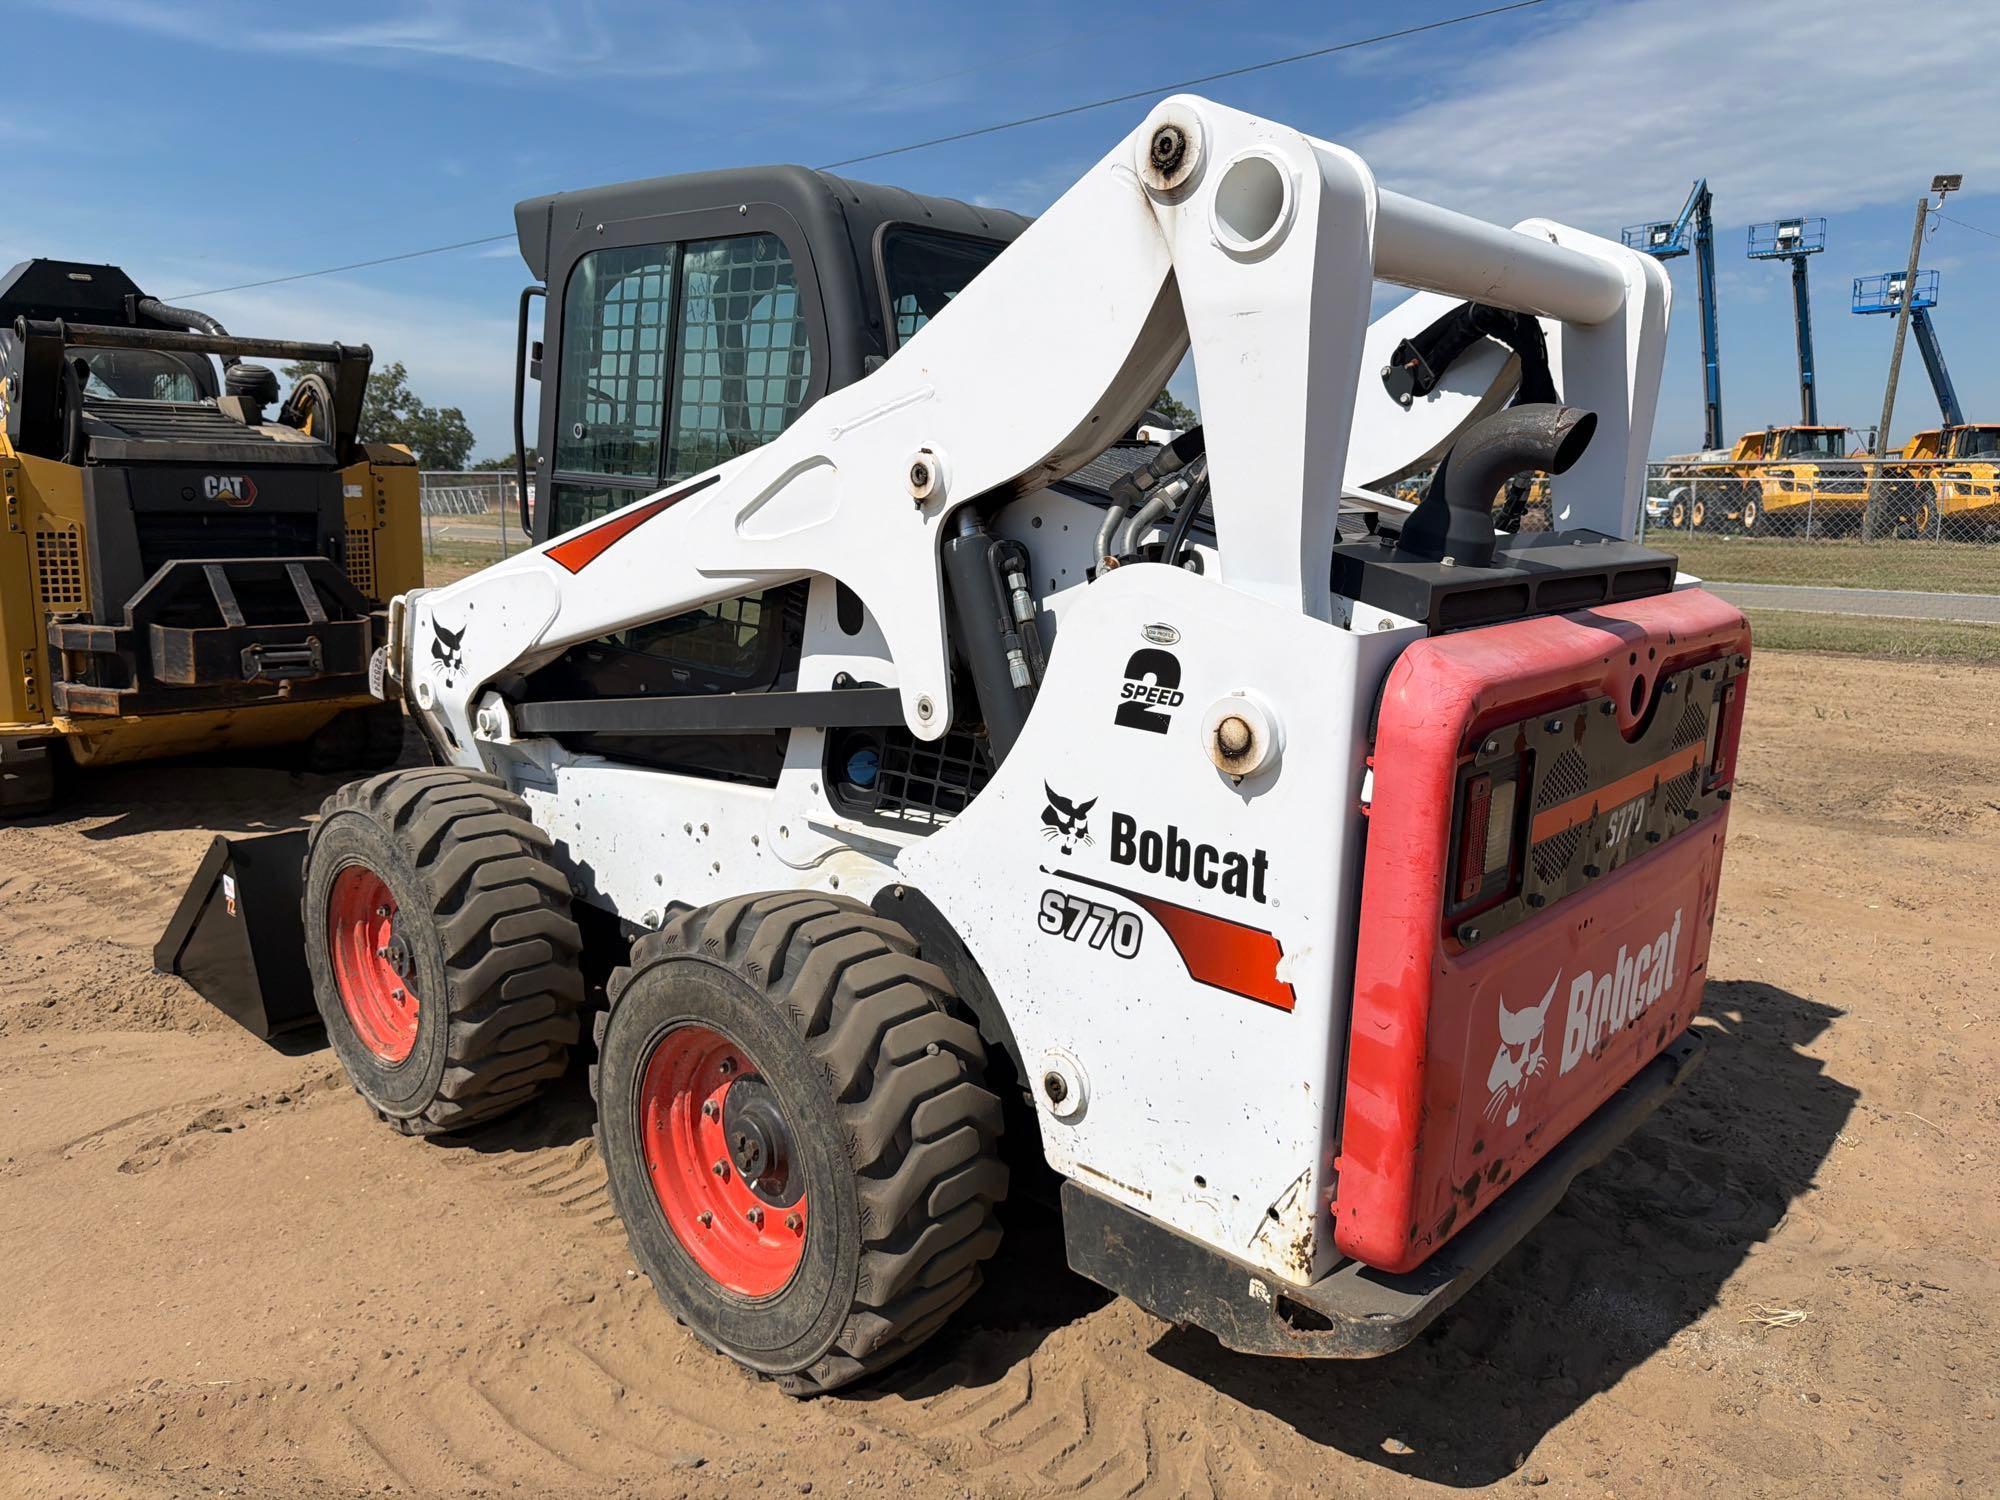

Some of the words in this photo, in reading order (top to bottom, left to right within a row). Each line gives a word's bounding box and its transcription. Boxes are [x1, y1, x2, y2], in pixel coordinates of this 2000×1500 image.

[204, 475, 243, 499] CAT
[1114, 648, 1181, 735] 2
[1120, 683, 1184, 707] SPEED
[1110, 811, 1268, 904] Bobcat
[1038, 888, 1143, 960] S770
[1559, 907, 1682, 1077] Bobcat
